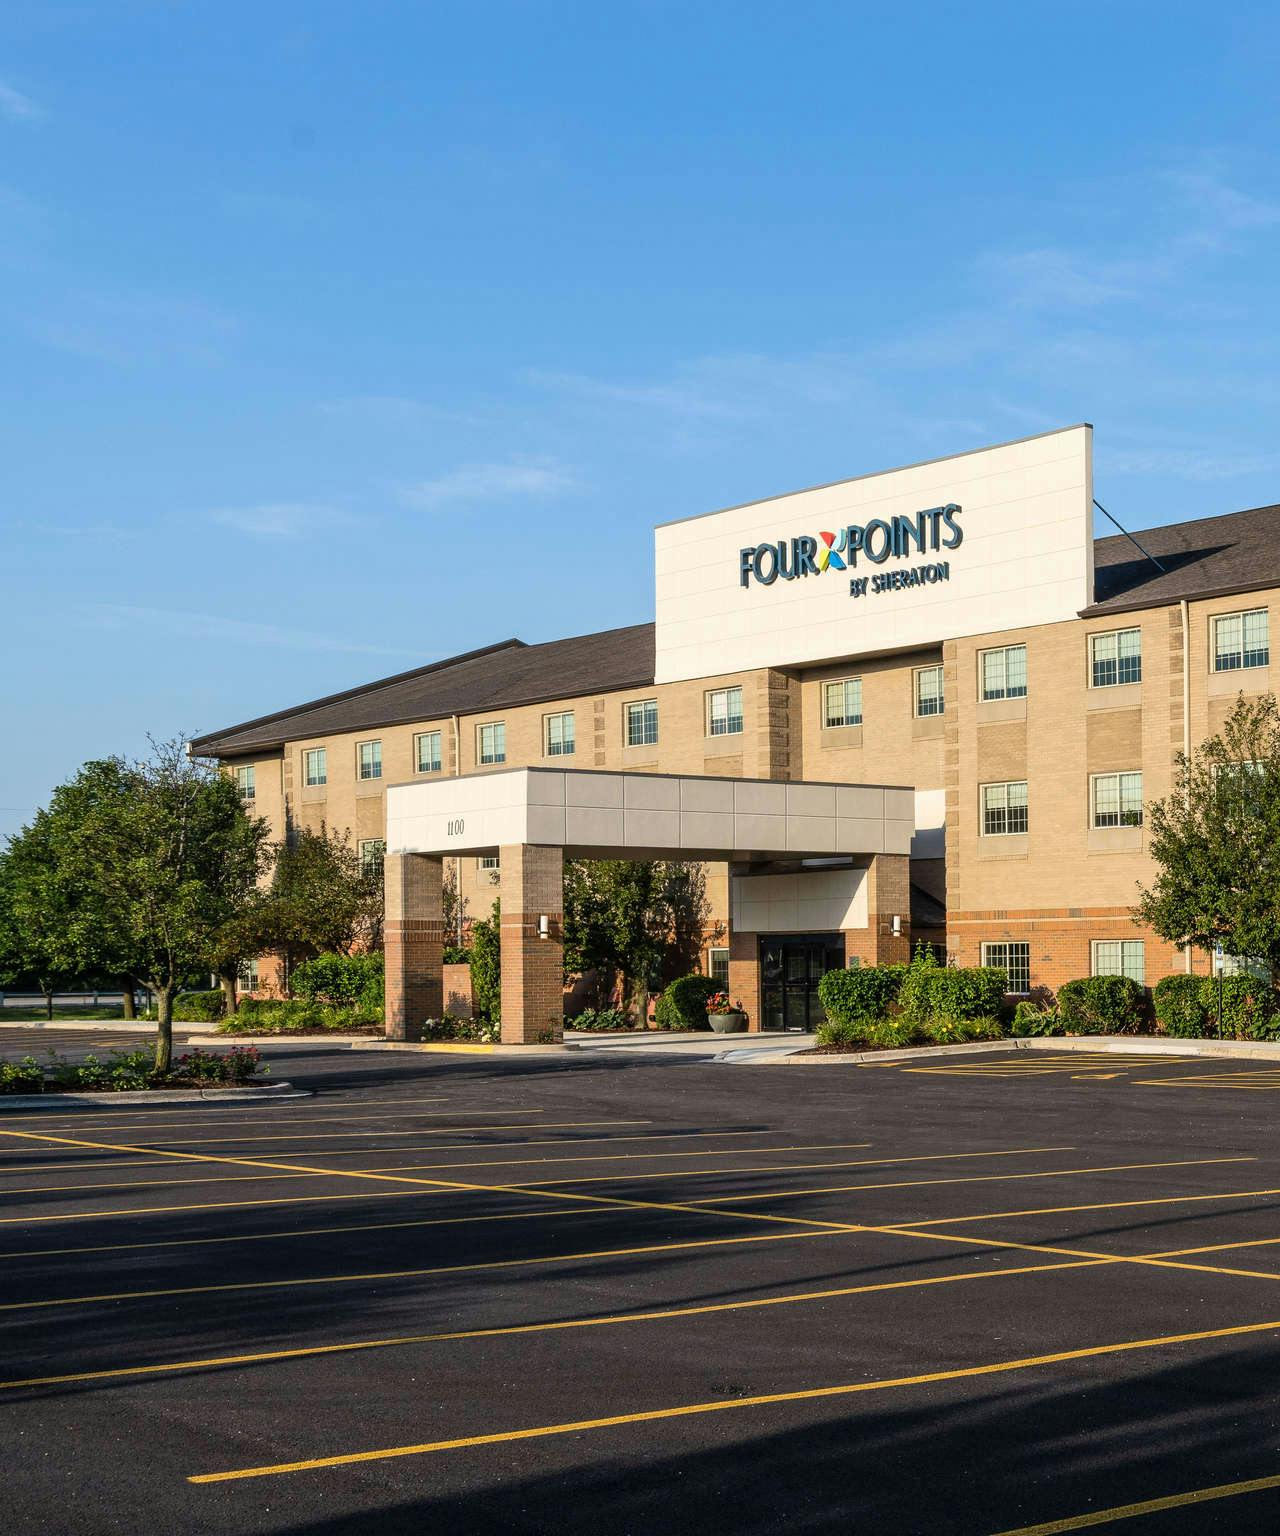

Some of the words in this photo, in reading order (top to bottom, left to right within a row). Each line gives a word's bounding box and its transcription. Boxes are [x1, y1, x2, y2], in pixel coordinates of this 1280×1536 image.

[740, 535, 820, 589] FOUR
[847, 503, 963, 568] POINTS
[850, 577, 868, 598] BY
[871, 562, 949, 594] SHERATON
[447, 819, 465, 836] 1100
